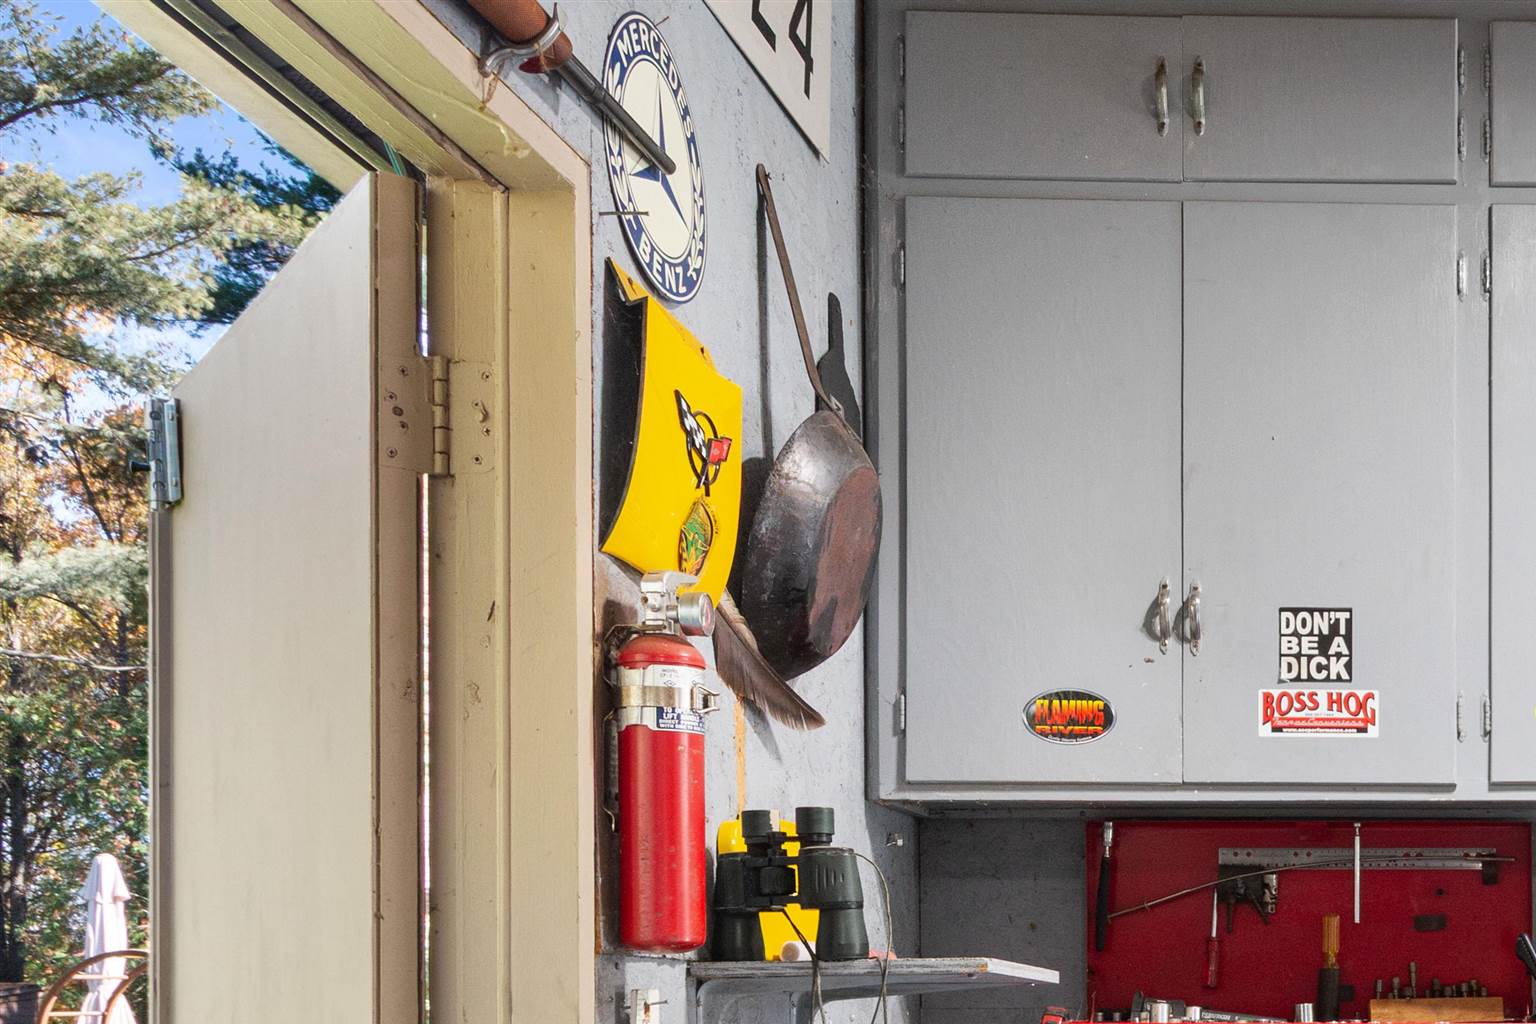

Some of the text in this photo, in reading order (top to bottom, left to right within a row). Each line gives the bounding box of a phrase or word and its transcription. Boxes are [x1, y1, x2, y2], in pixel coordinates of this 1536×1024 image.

[617, 22, 693, 138] MERCEDES
[639, 231, 687, 294] BENZ
[1280, 611, 1350, 635] DON'T
[1280, 636, 1350, 655] BE A
[1280, 656, 1350, 680] DICK
[1035, 699, 1105, 726] FLAMING
[1262, 691, 1376, 726] BOSS HOG
[1035, 726, 1104, 735] RIVER
